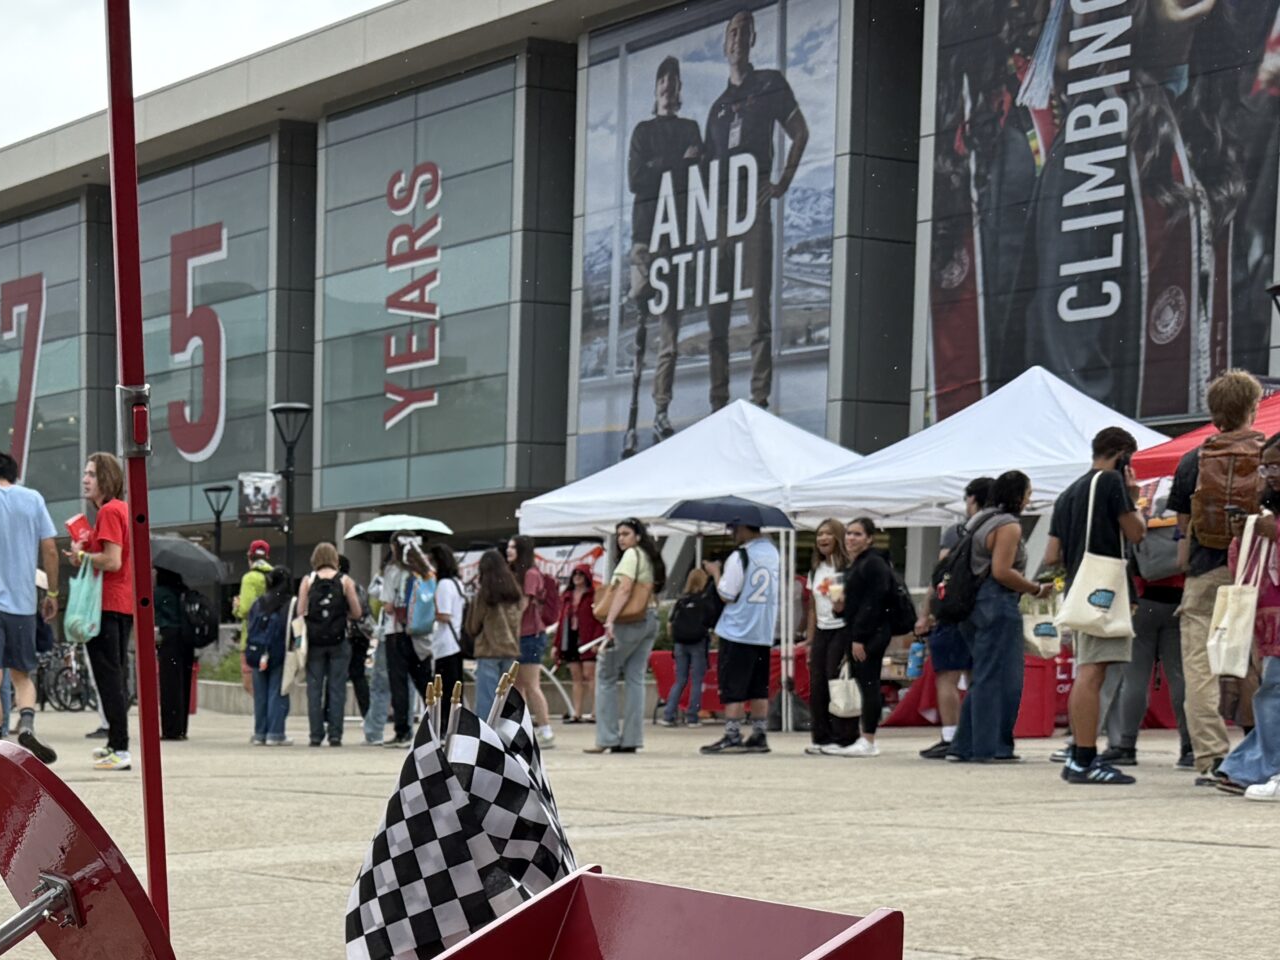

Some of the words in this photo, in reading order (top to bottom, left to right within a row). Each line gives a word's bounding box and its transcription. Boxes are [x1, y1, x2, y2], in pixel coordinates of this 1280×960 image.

[649, 152, 758, 254] AND
[383, 160, 442, 430] YEARS
[647, 241, 754, 315] STILL
[747, 567, 770, 604] 2
